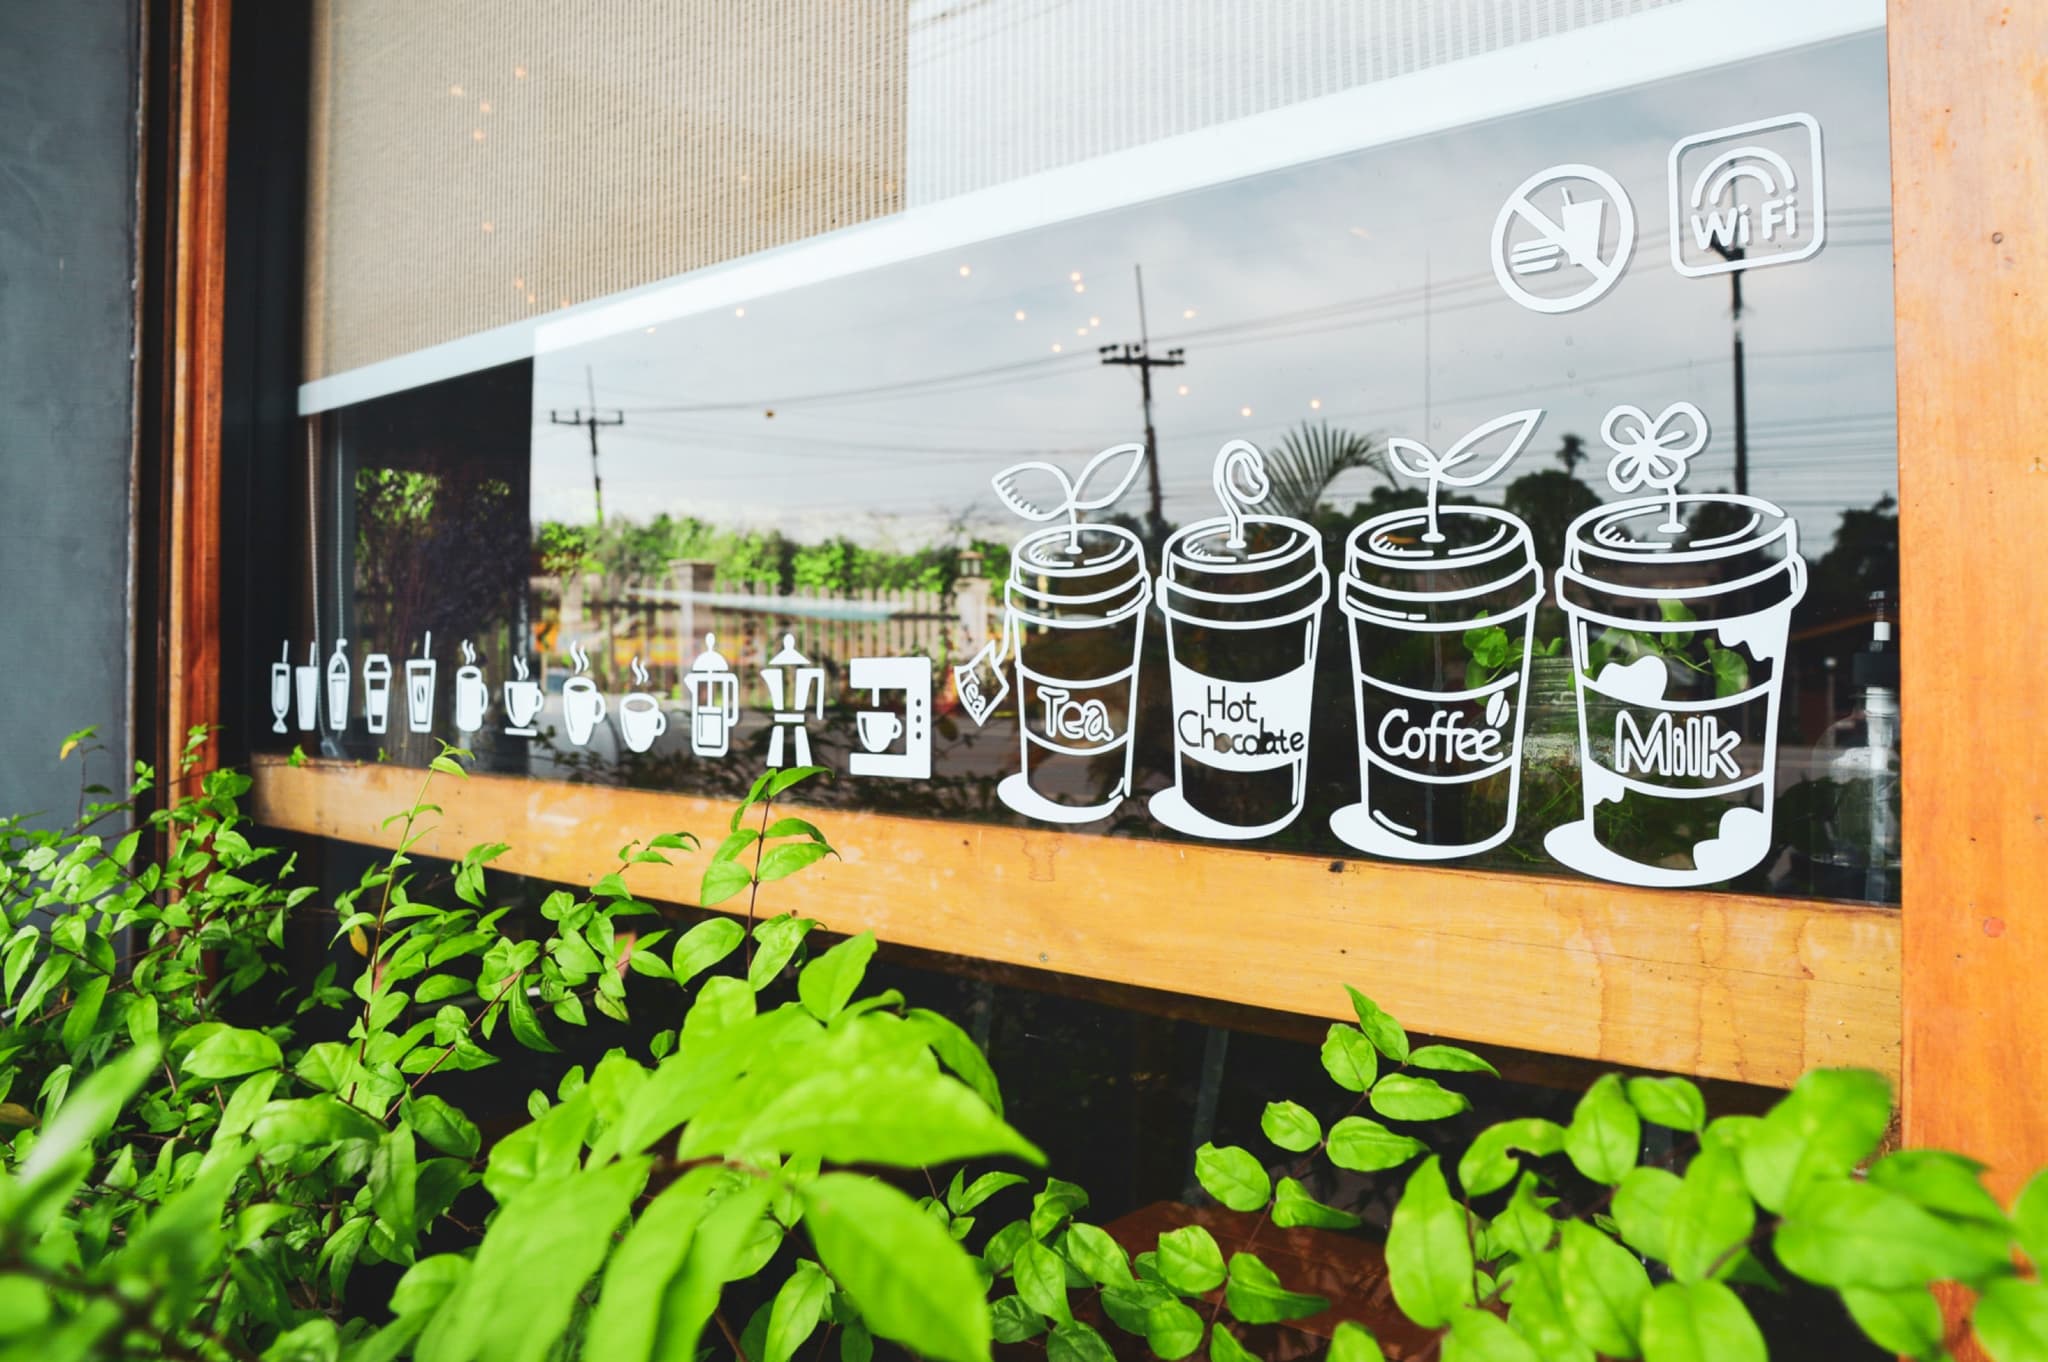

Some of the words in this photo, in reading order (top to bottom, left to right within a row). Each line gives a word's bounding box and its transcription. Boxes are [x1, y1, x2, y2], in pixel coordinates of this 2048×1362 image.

[959, 667, 987, 716] Tea
[1037, 686, 1114, 741] Tea
[1207, 685, 1258, 723] Hot
[1178, 710, 1304, 756] Chocolate
[1378, 708, 1503, 763] Coffee
[1615, 710, 1742, 779] Milk
